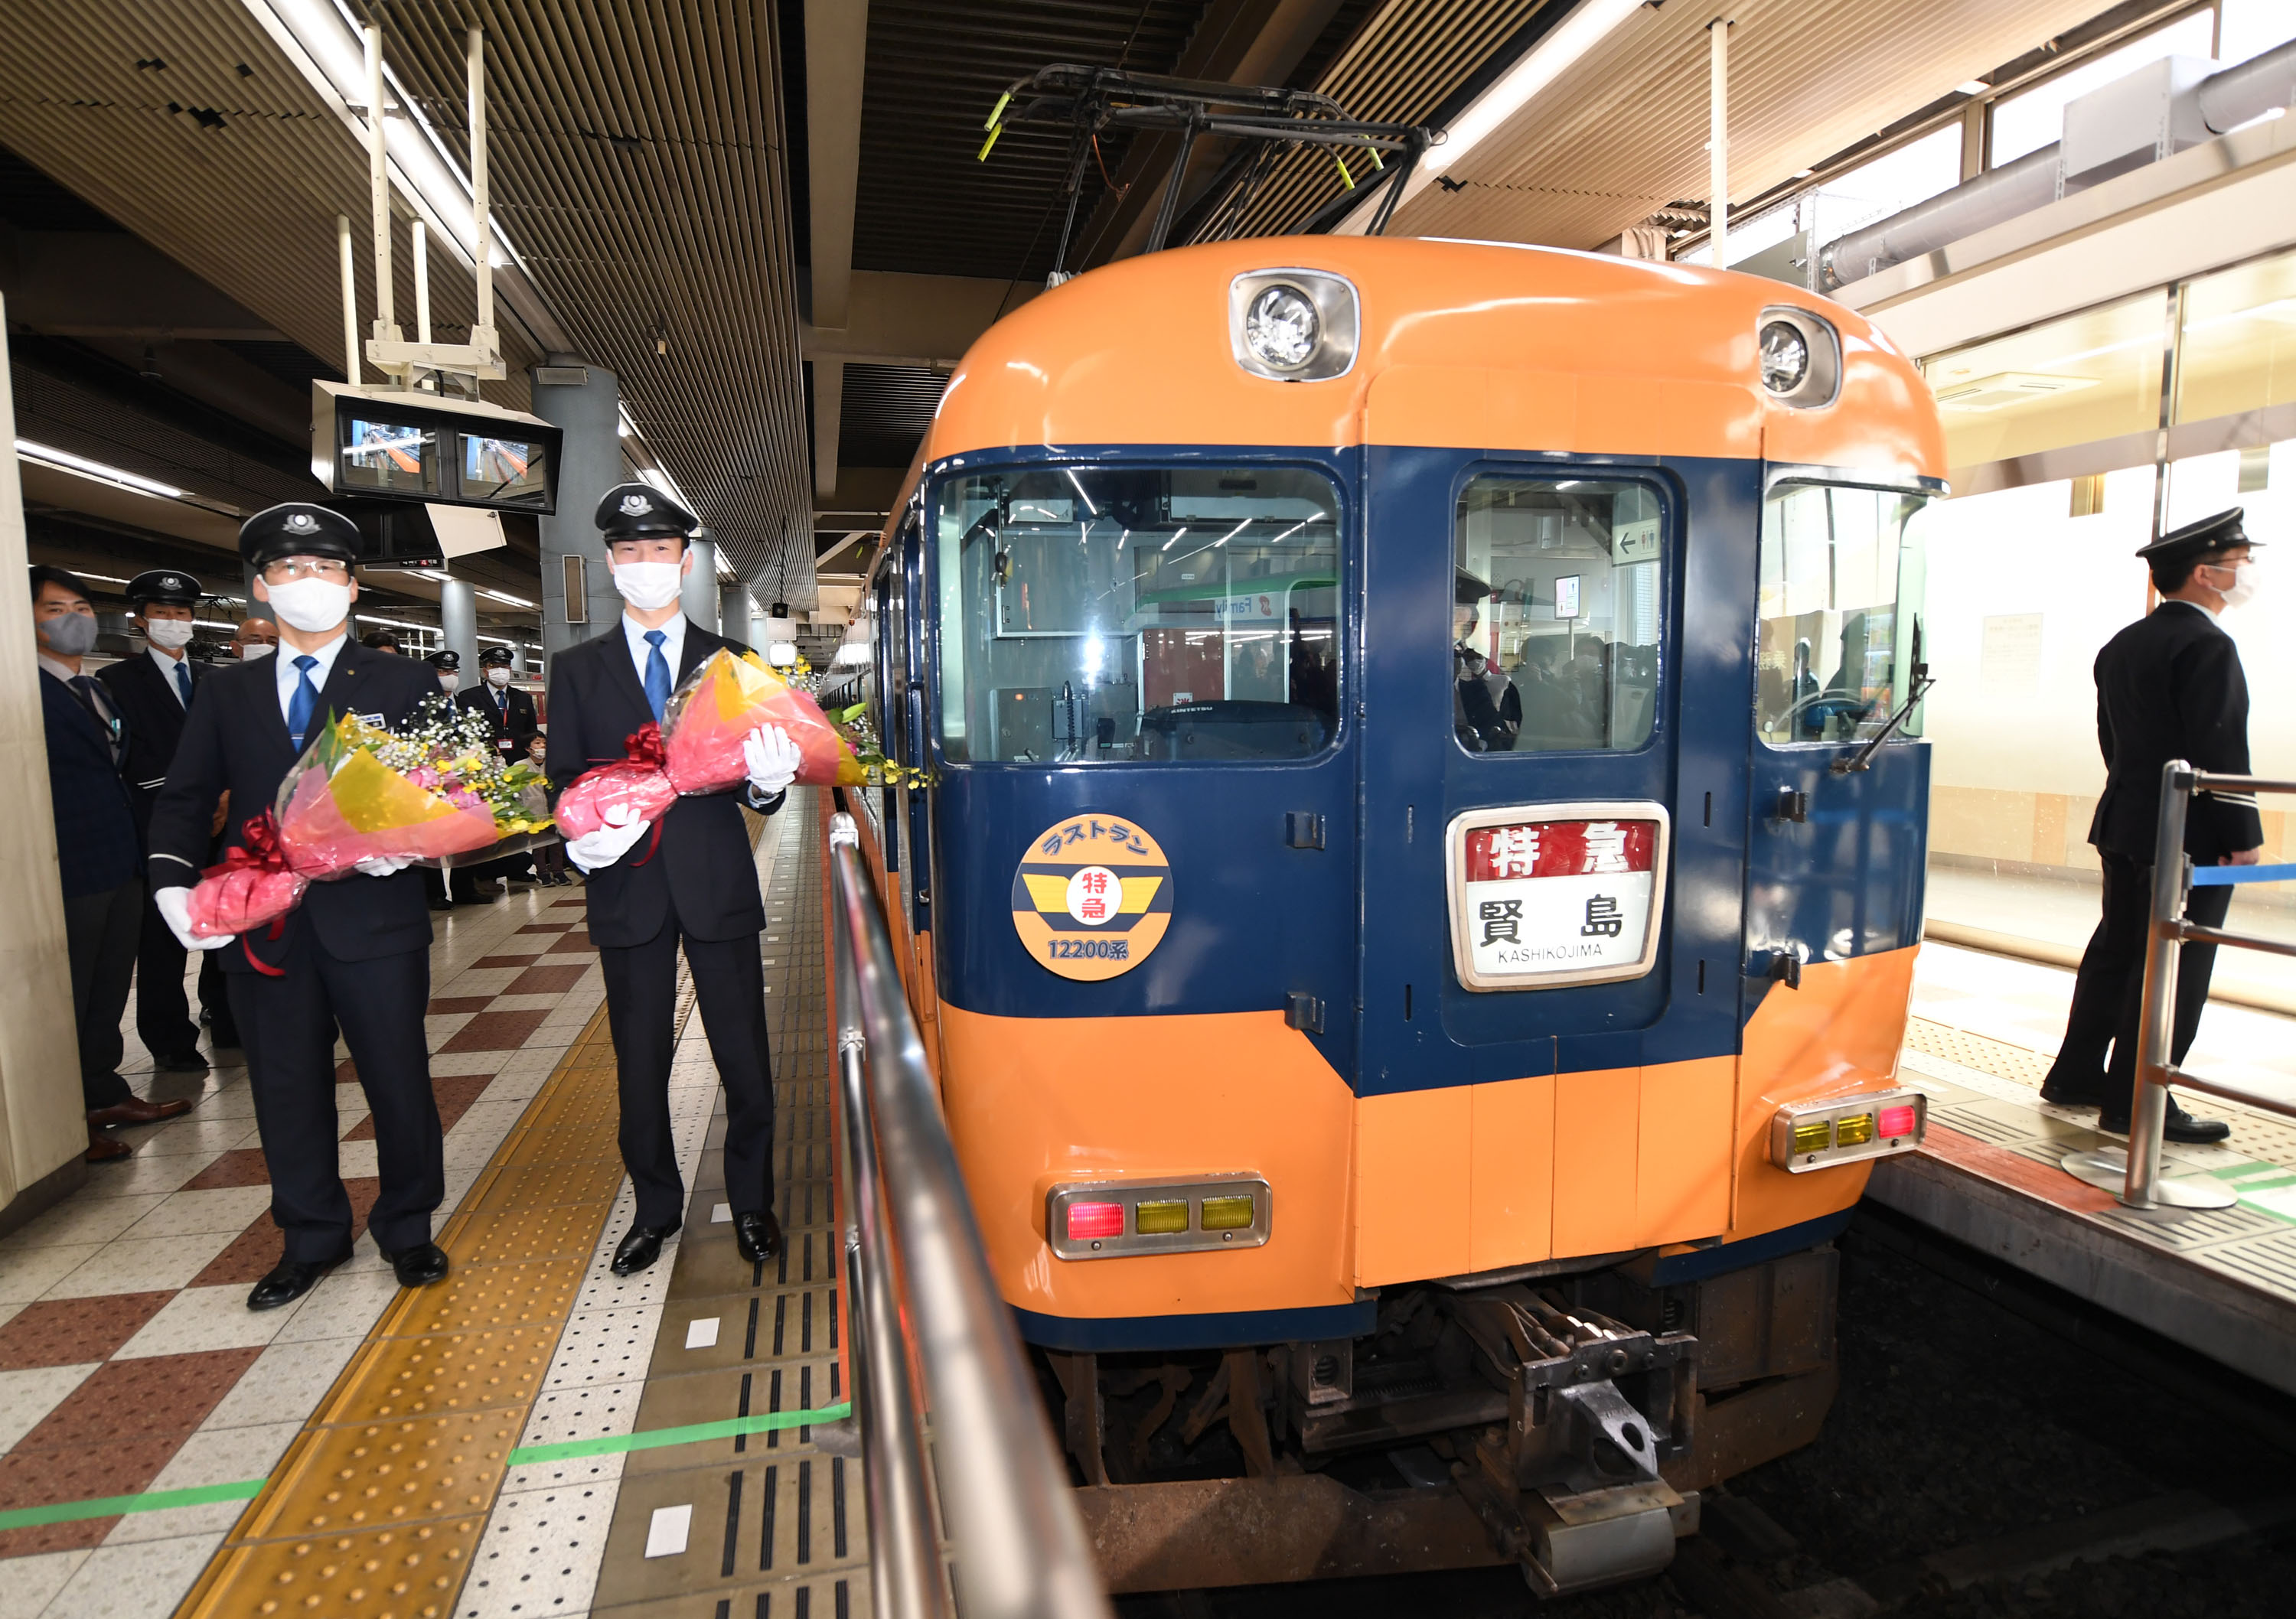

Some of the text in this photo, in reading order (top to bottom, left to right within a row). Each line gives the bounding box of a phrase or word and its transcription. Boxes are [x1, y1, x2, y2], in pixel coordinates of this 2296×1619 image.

[1041, 820, 1149, 856] ラストラン
[1490, 821, 1628, 878] 特急
[1081, 872, 1107, 918] 特急
[1479, 894, 1623, 948] 賢島
[1048, 939, 1129, 960] 12200系
[1498, 943, 1603, 964] KASHIKOJIMA
